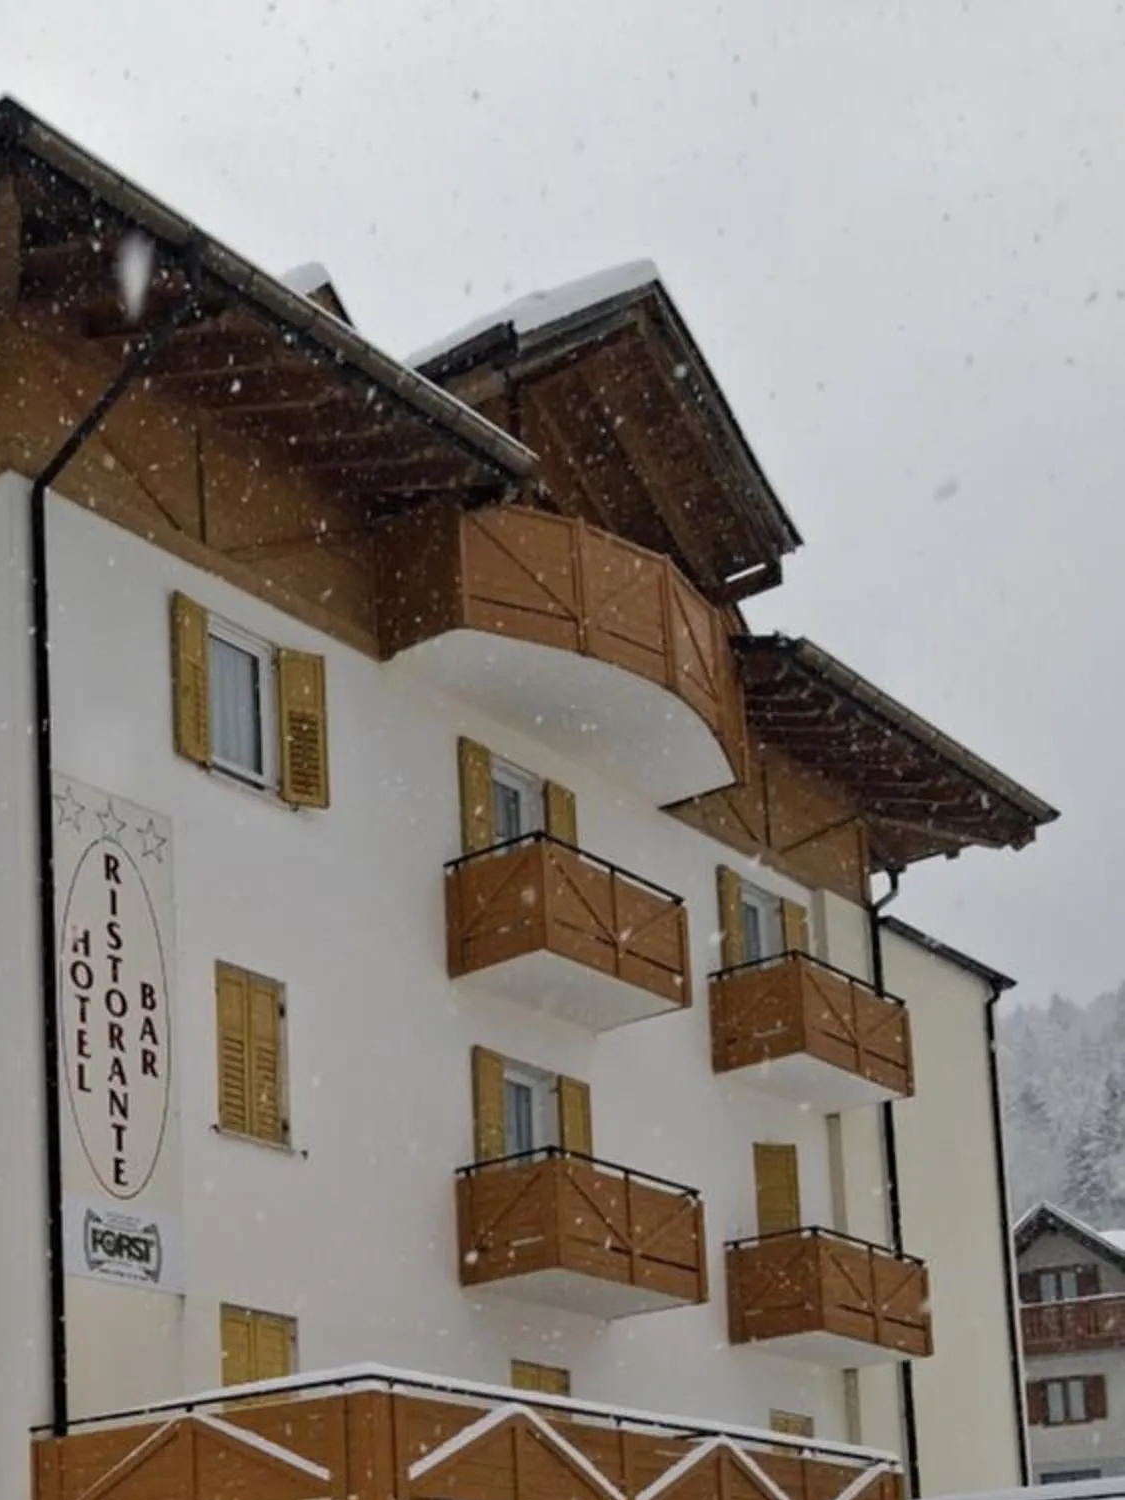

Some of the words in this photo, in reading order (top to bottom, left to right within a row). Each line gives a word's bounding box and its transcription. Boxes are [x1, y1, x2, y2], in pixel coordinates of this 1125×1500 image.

[70, 925, 93, 1093] HOTEL
[104, 852, 129, 1186] RISTORANTE
[139, 981, 158, 1078] BAR
[91, 1227, 154, 1263] FORST
